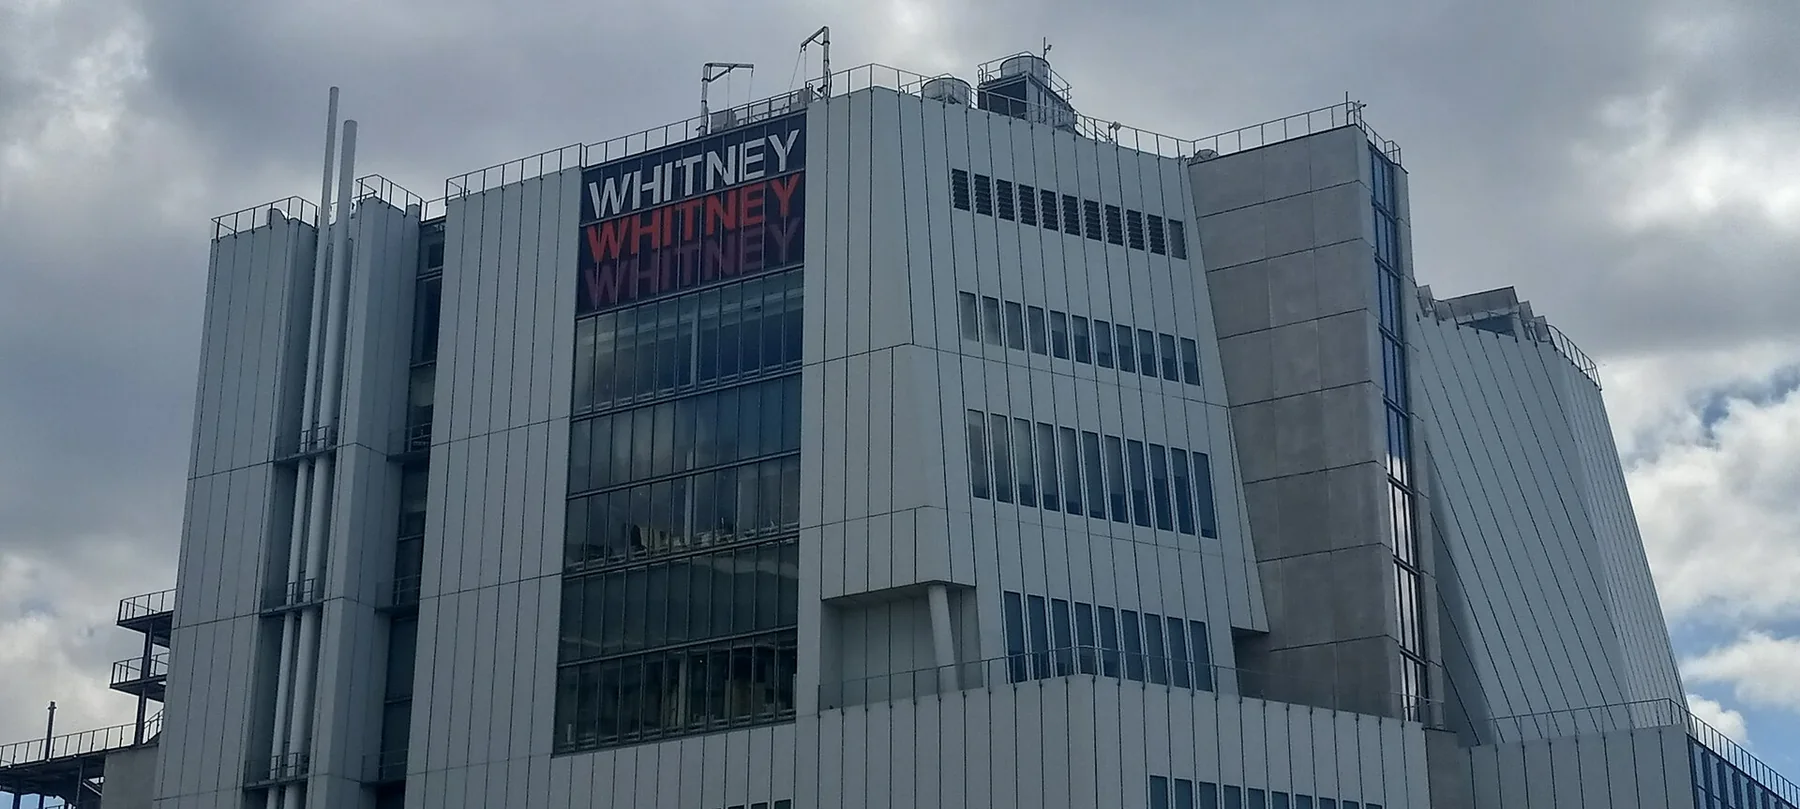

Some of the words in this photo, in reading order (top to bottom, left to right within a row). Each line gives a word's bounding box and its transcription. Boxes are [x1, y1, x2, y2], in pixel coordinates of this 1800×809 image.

[587, 174, 800, 263] WHITNEY
[589, 129, 800, 219] WHITNEY
[584, 217, 800, 307] WHITNEY
